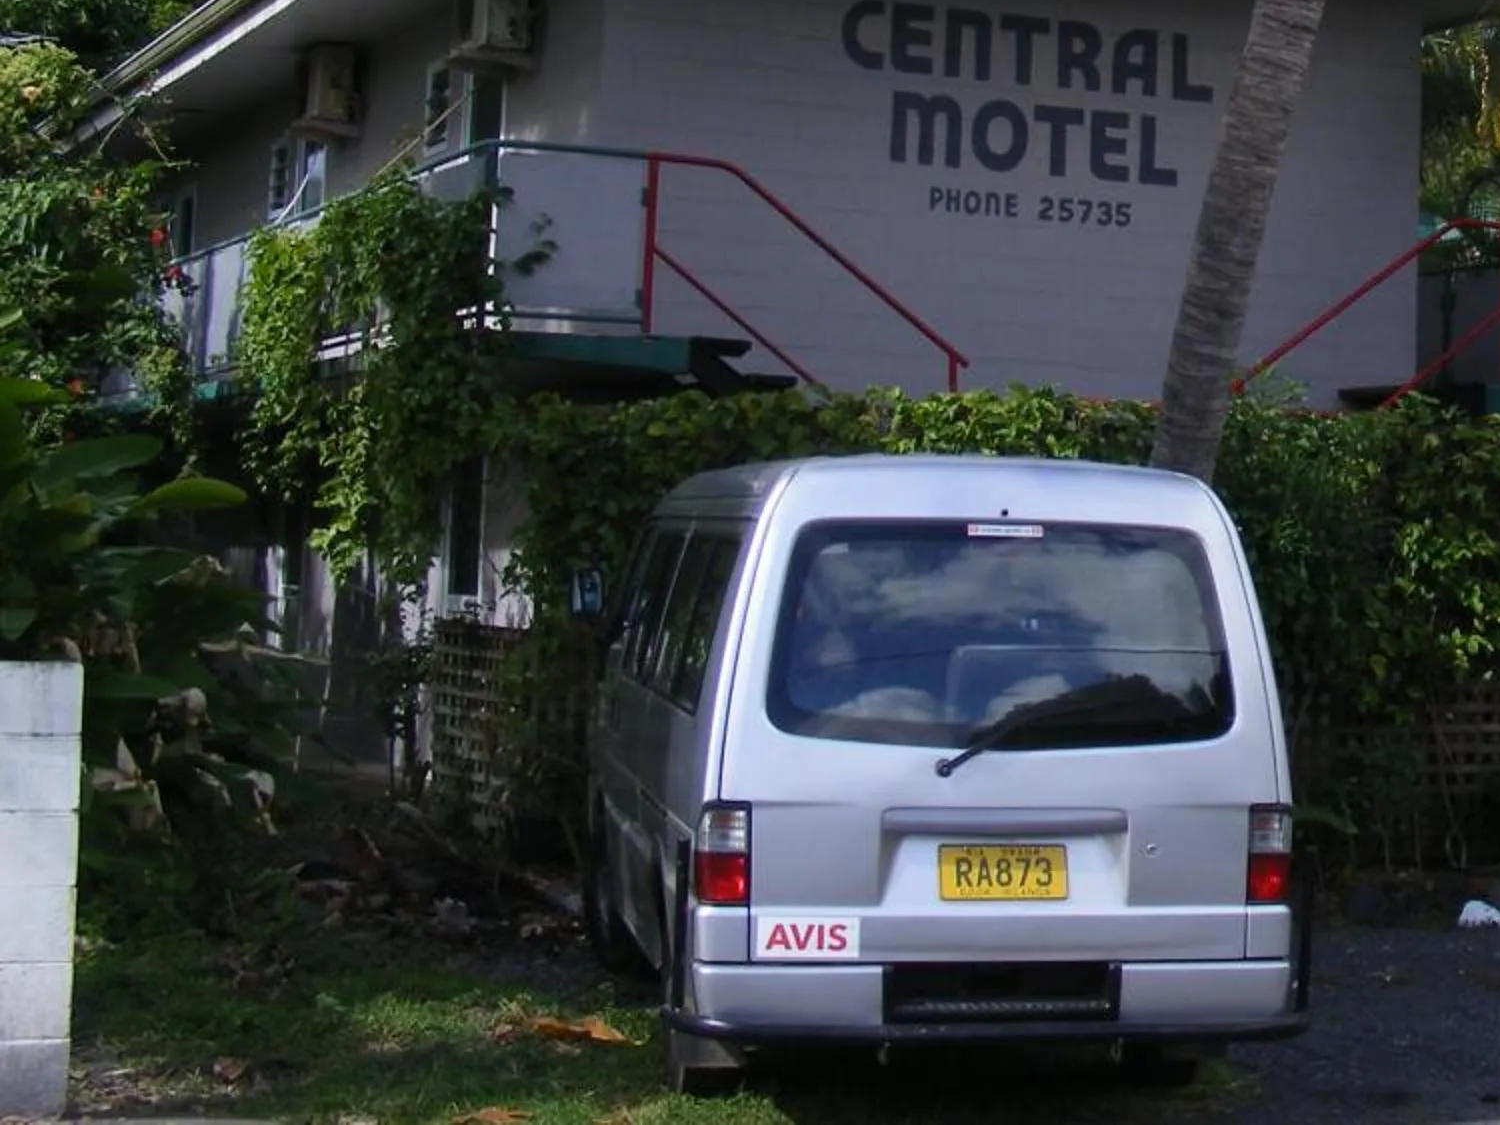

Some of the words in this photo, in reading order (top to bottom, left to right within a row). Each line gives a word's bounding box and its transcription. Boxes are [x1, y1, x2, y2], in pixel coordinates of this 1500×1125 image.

[842, 0, 1214, 103] CENTRAL
[889, 90, 1179, 186] MOTEL
[929, 186, 1018, 218] PHONE
[1038, 196, 1132, 227] 25735
[955, 856, 1053, 887] RA873
[765, 922, 847, 952] AVIS
